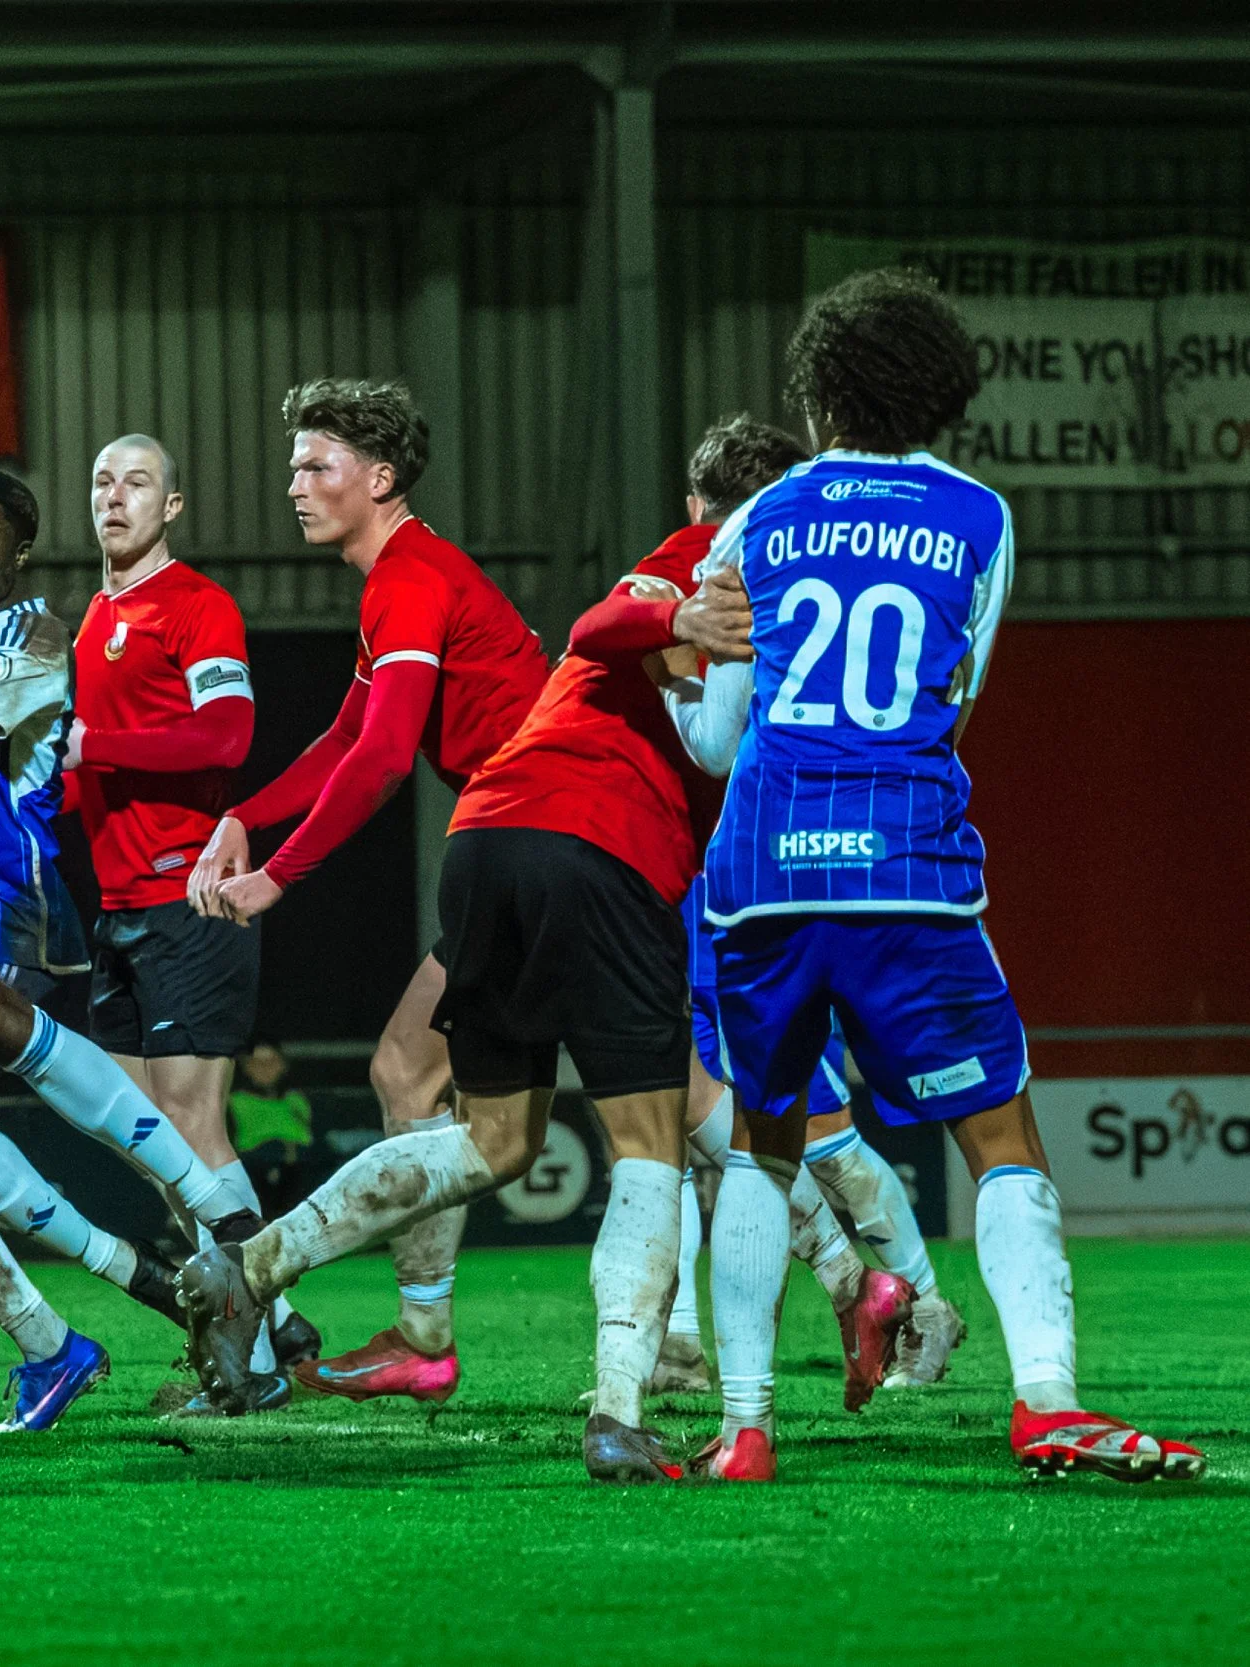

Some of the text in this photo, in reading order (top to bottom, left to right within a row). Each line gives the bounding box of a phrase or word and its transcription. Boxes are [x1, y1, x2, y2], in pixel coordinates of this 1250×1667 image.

[1028, 250, 1189, 297] FALLEN
[951, 419, 1118, 466] FALLEN
[766, 521, 965, 577] OLUFOWOBI
[767, 577, 926, 732] 20
[779, 831, 873, 860] HiSPEC
